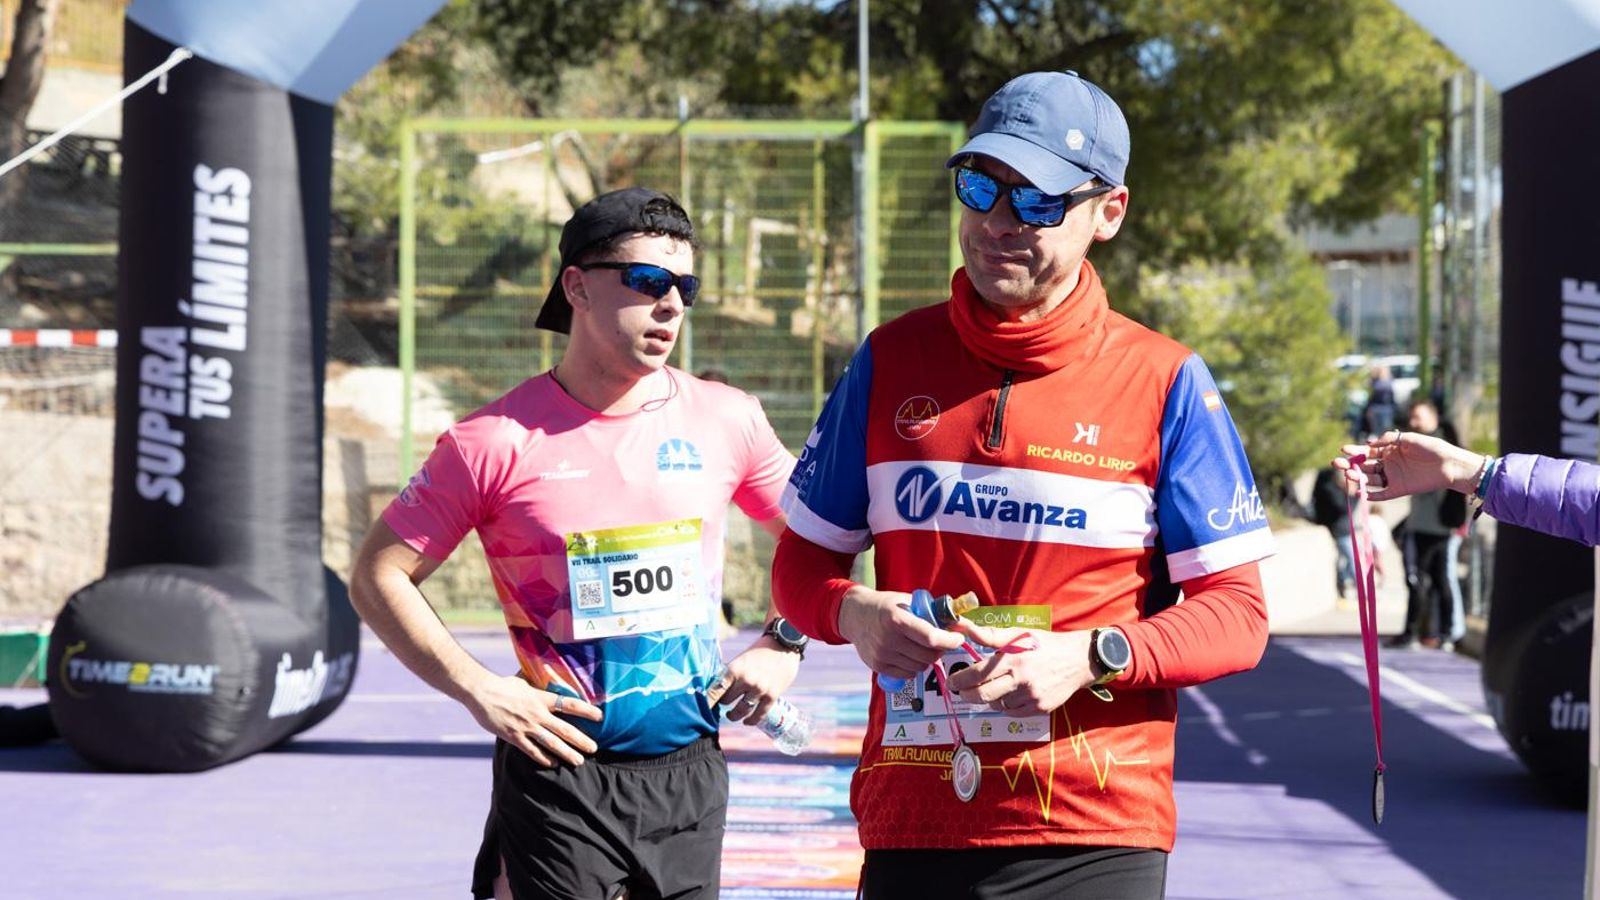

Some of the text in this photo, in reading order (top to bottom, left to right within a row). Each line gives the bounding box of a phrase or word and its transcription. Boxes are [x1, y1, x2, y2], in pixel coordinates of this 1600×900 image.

[178, 163, 252, 419] TUS LÍMITES
[136, 327, 187, 506] SUPERA
[1026, 444, 1137, 472] RICARDO LIRIO
[943, 481, 1087, 530] Avanza
[975, 484, 1008, 497] GRUPO
[583, 557, 601, 565] TRAIL
[603, 553, 639, 563] SOLIDARIO
[612, 565, 673, 597] 500
[984, 612, 1011, 624] CxM
[69, 658, 214, 688] TIME2RUN
